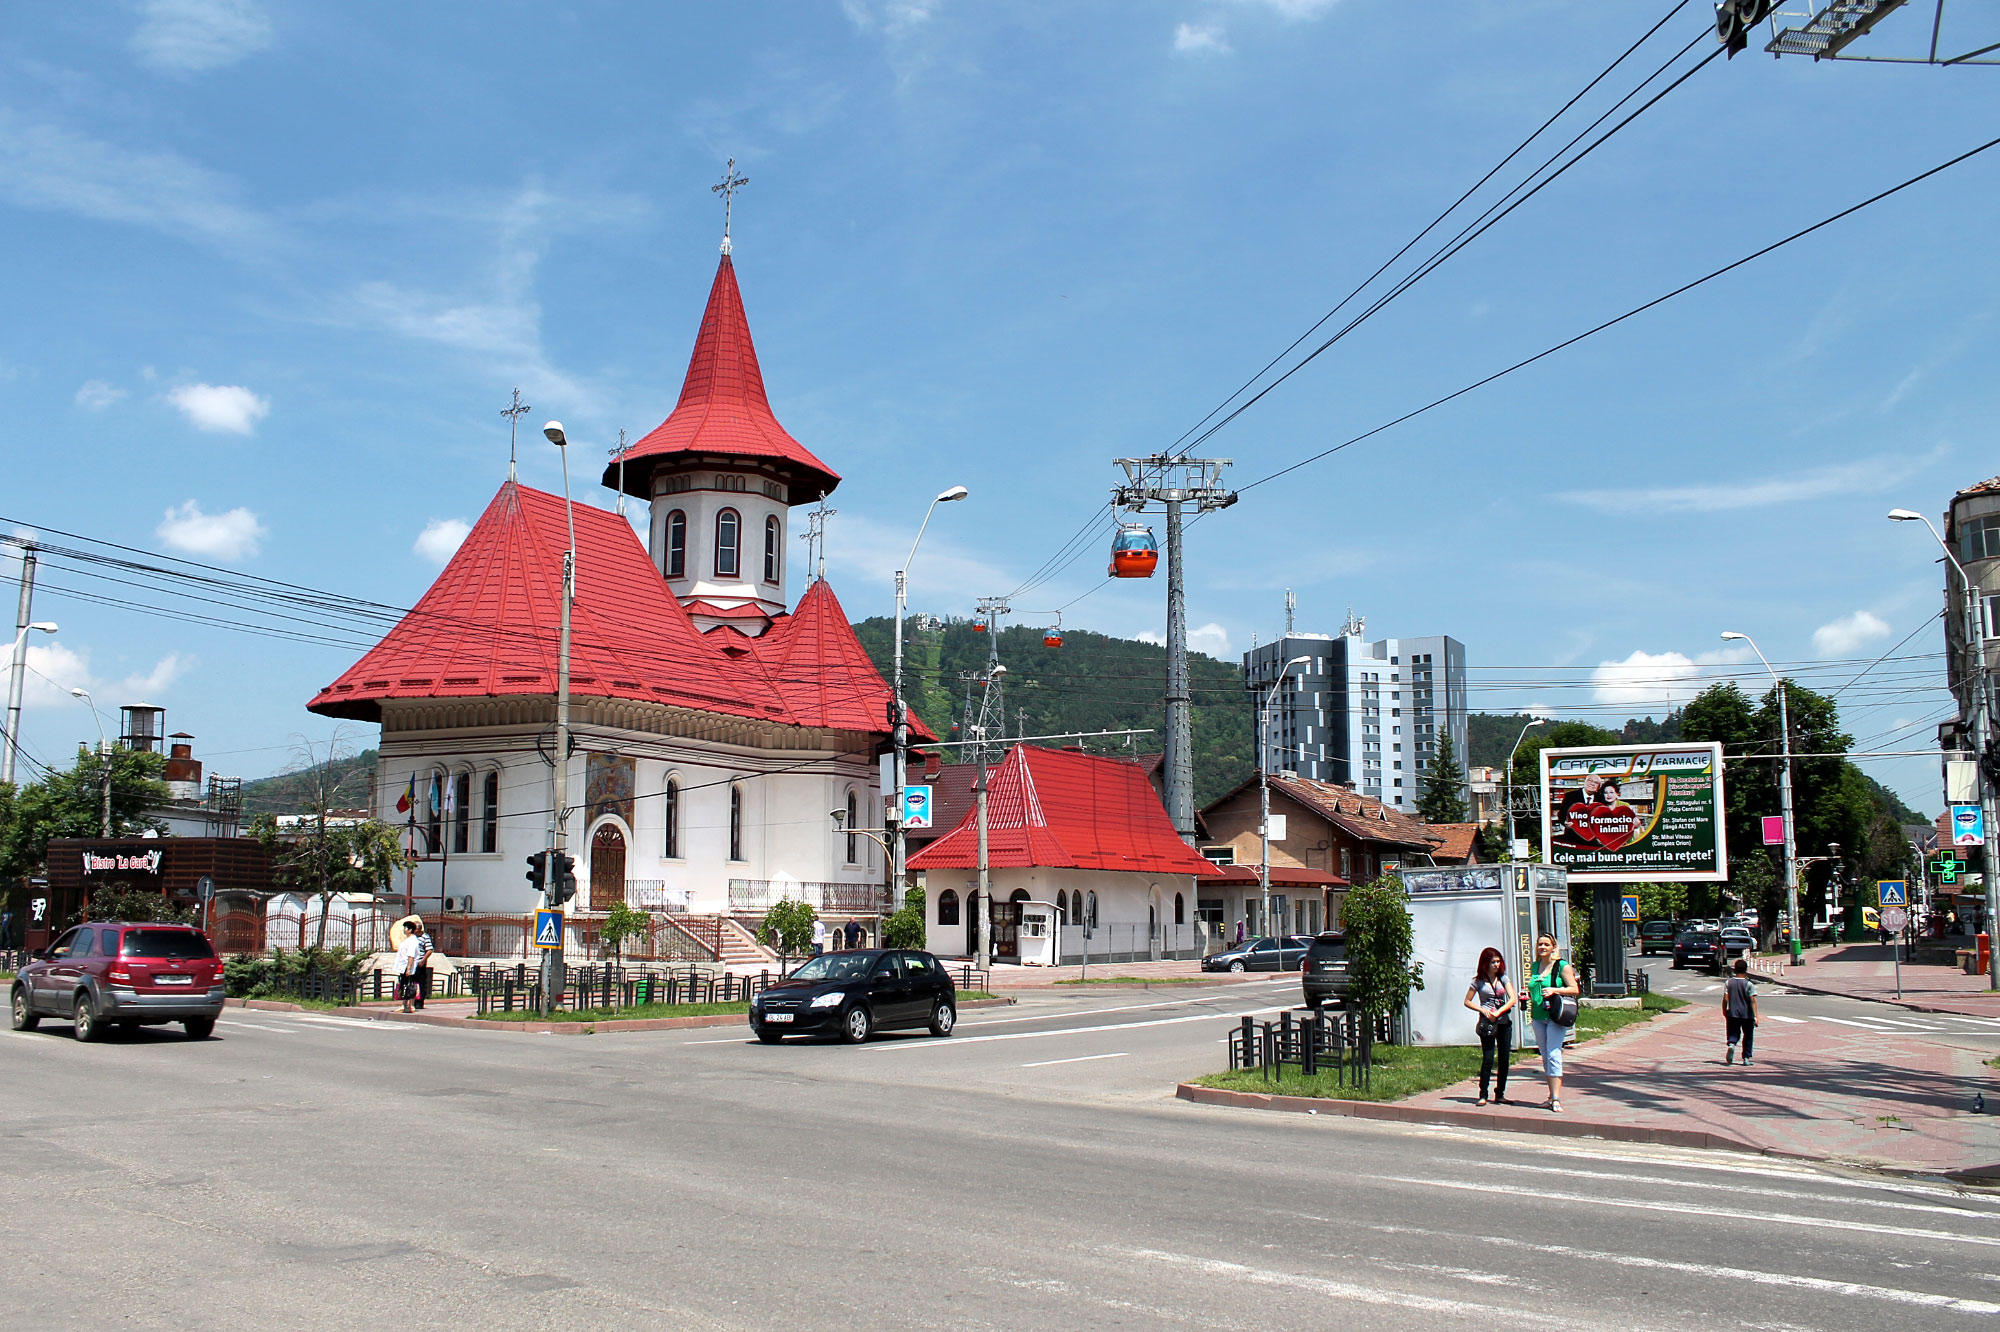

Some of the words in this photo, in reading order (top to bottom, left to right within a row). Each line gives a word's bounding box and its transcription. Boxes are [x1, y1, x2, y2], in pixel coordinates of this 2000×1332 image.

[1559, 758, 1627, 771] CATENA
[1655, 756, 1708, 766] FARMACIE
[1569, 811, 1588, 819] Vino
[1579, 819, 1588, 828] la
[1590, 815, 1633, 824] farmacia
[1599, 824, 1629, 833] inimii!
[91, 856, 116, 870] Bistro
[1553, 852, 1575, 863] Cele
[1576, 852, 1596, 863] mai
[1597, 851, 1624, 862] bune
[1663, 850, 1674, 861] la
[1881, 912, 1906, 926] STOP
